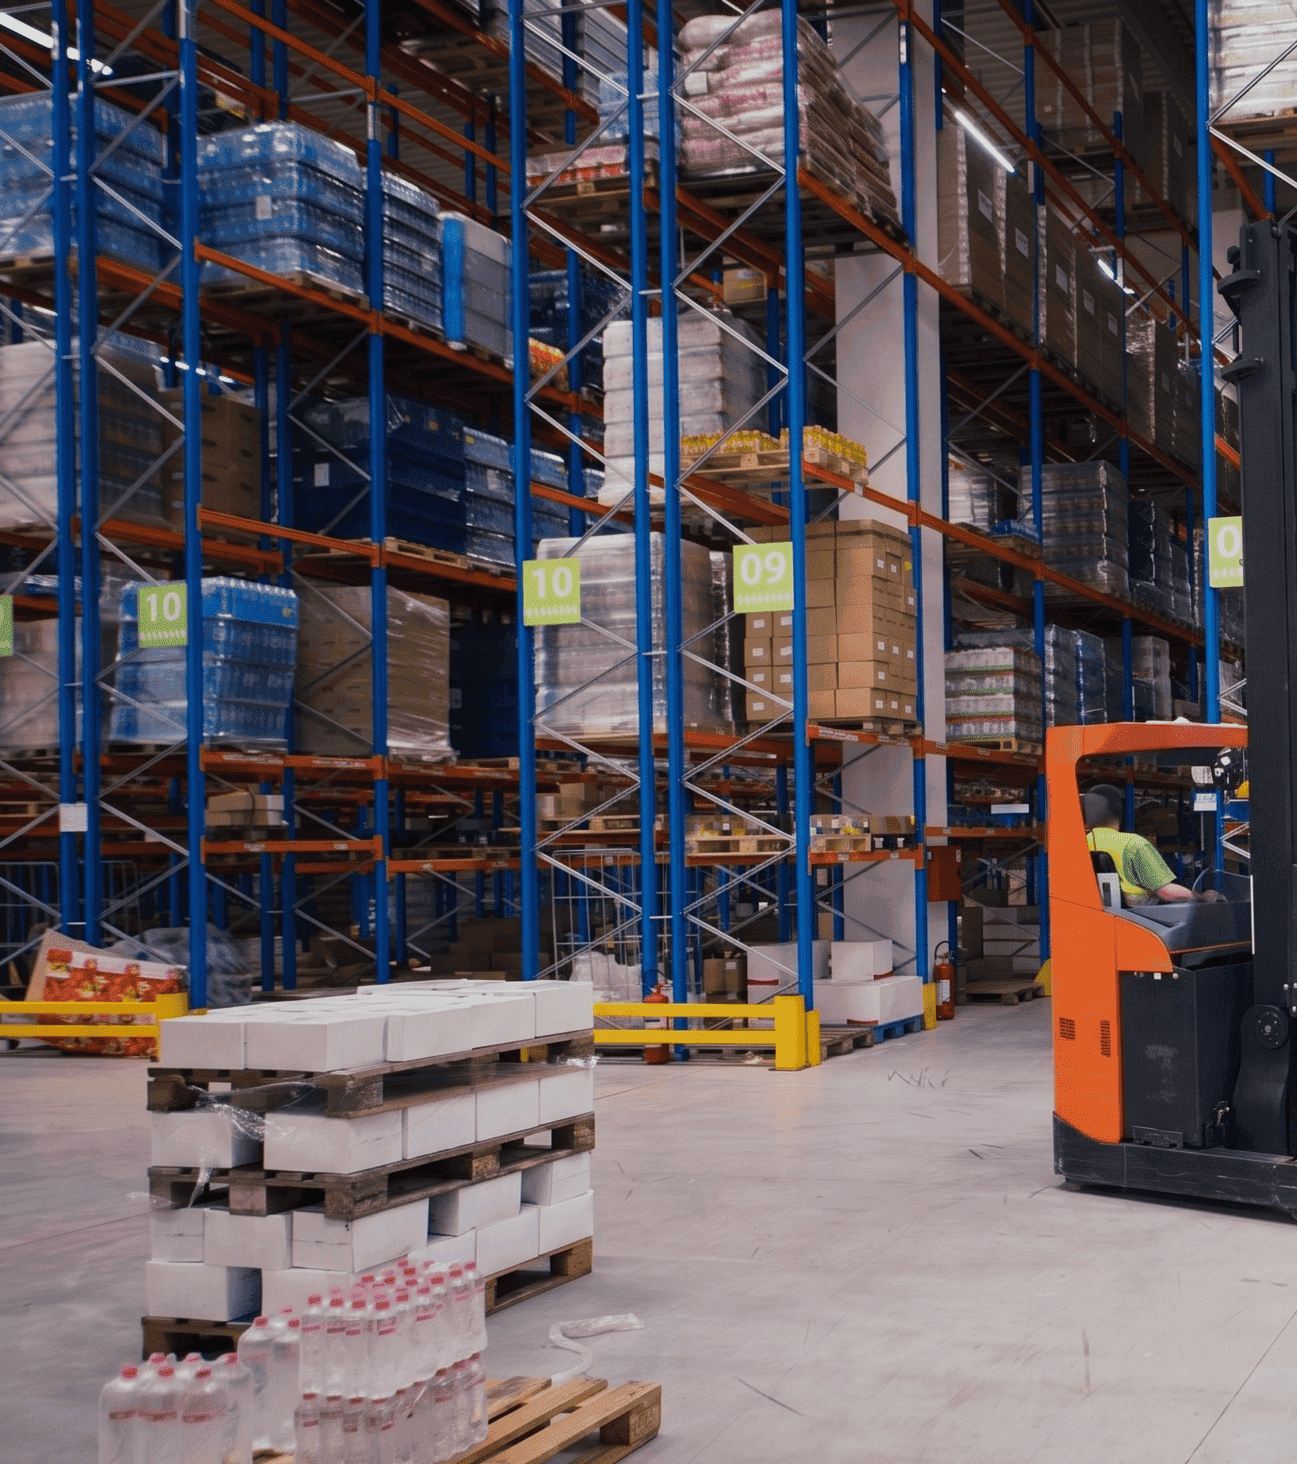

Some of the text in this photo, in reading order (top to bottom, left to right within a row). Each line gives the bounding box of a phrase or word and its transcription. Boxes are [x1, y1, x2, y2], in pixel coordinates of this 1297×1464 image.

[1217, 525, 1242, 558] 0
[532, 566, 574, 599] 10
[740, 551, 787, 586] 09
[146, 591, 182, 622] 10
